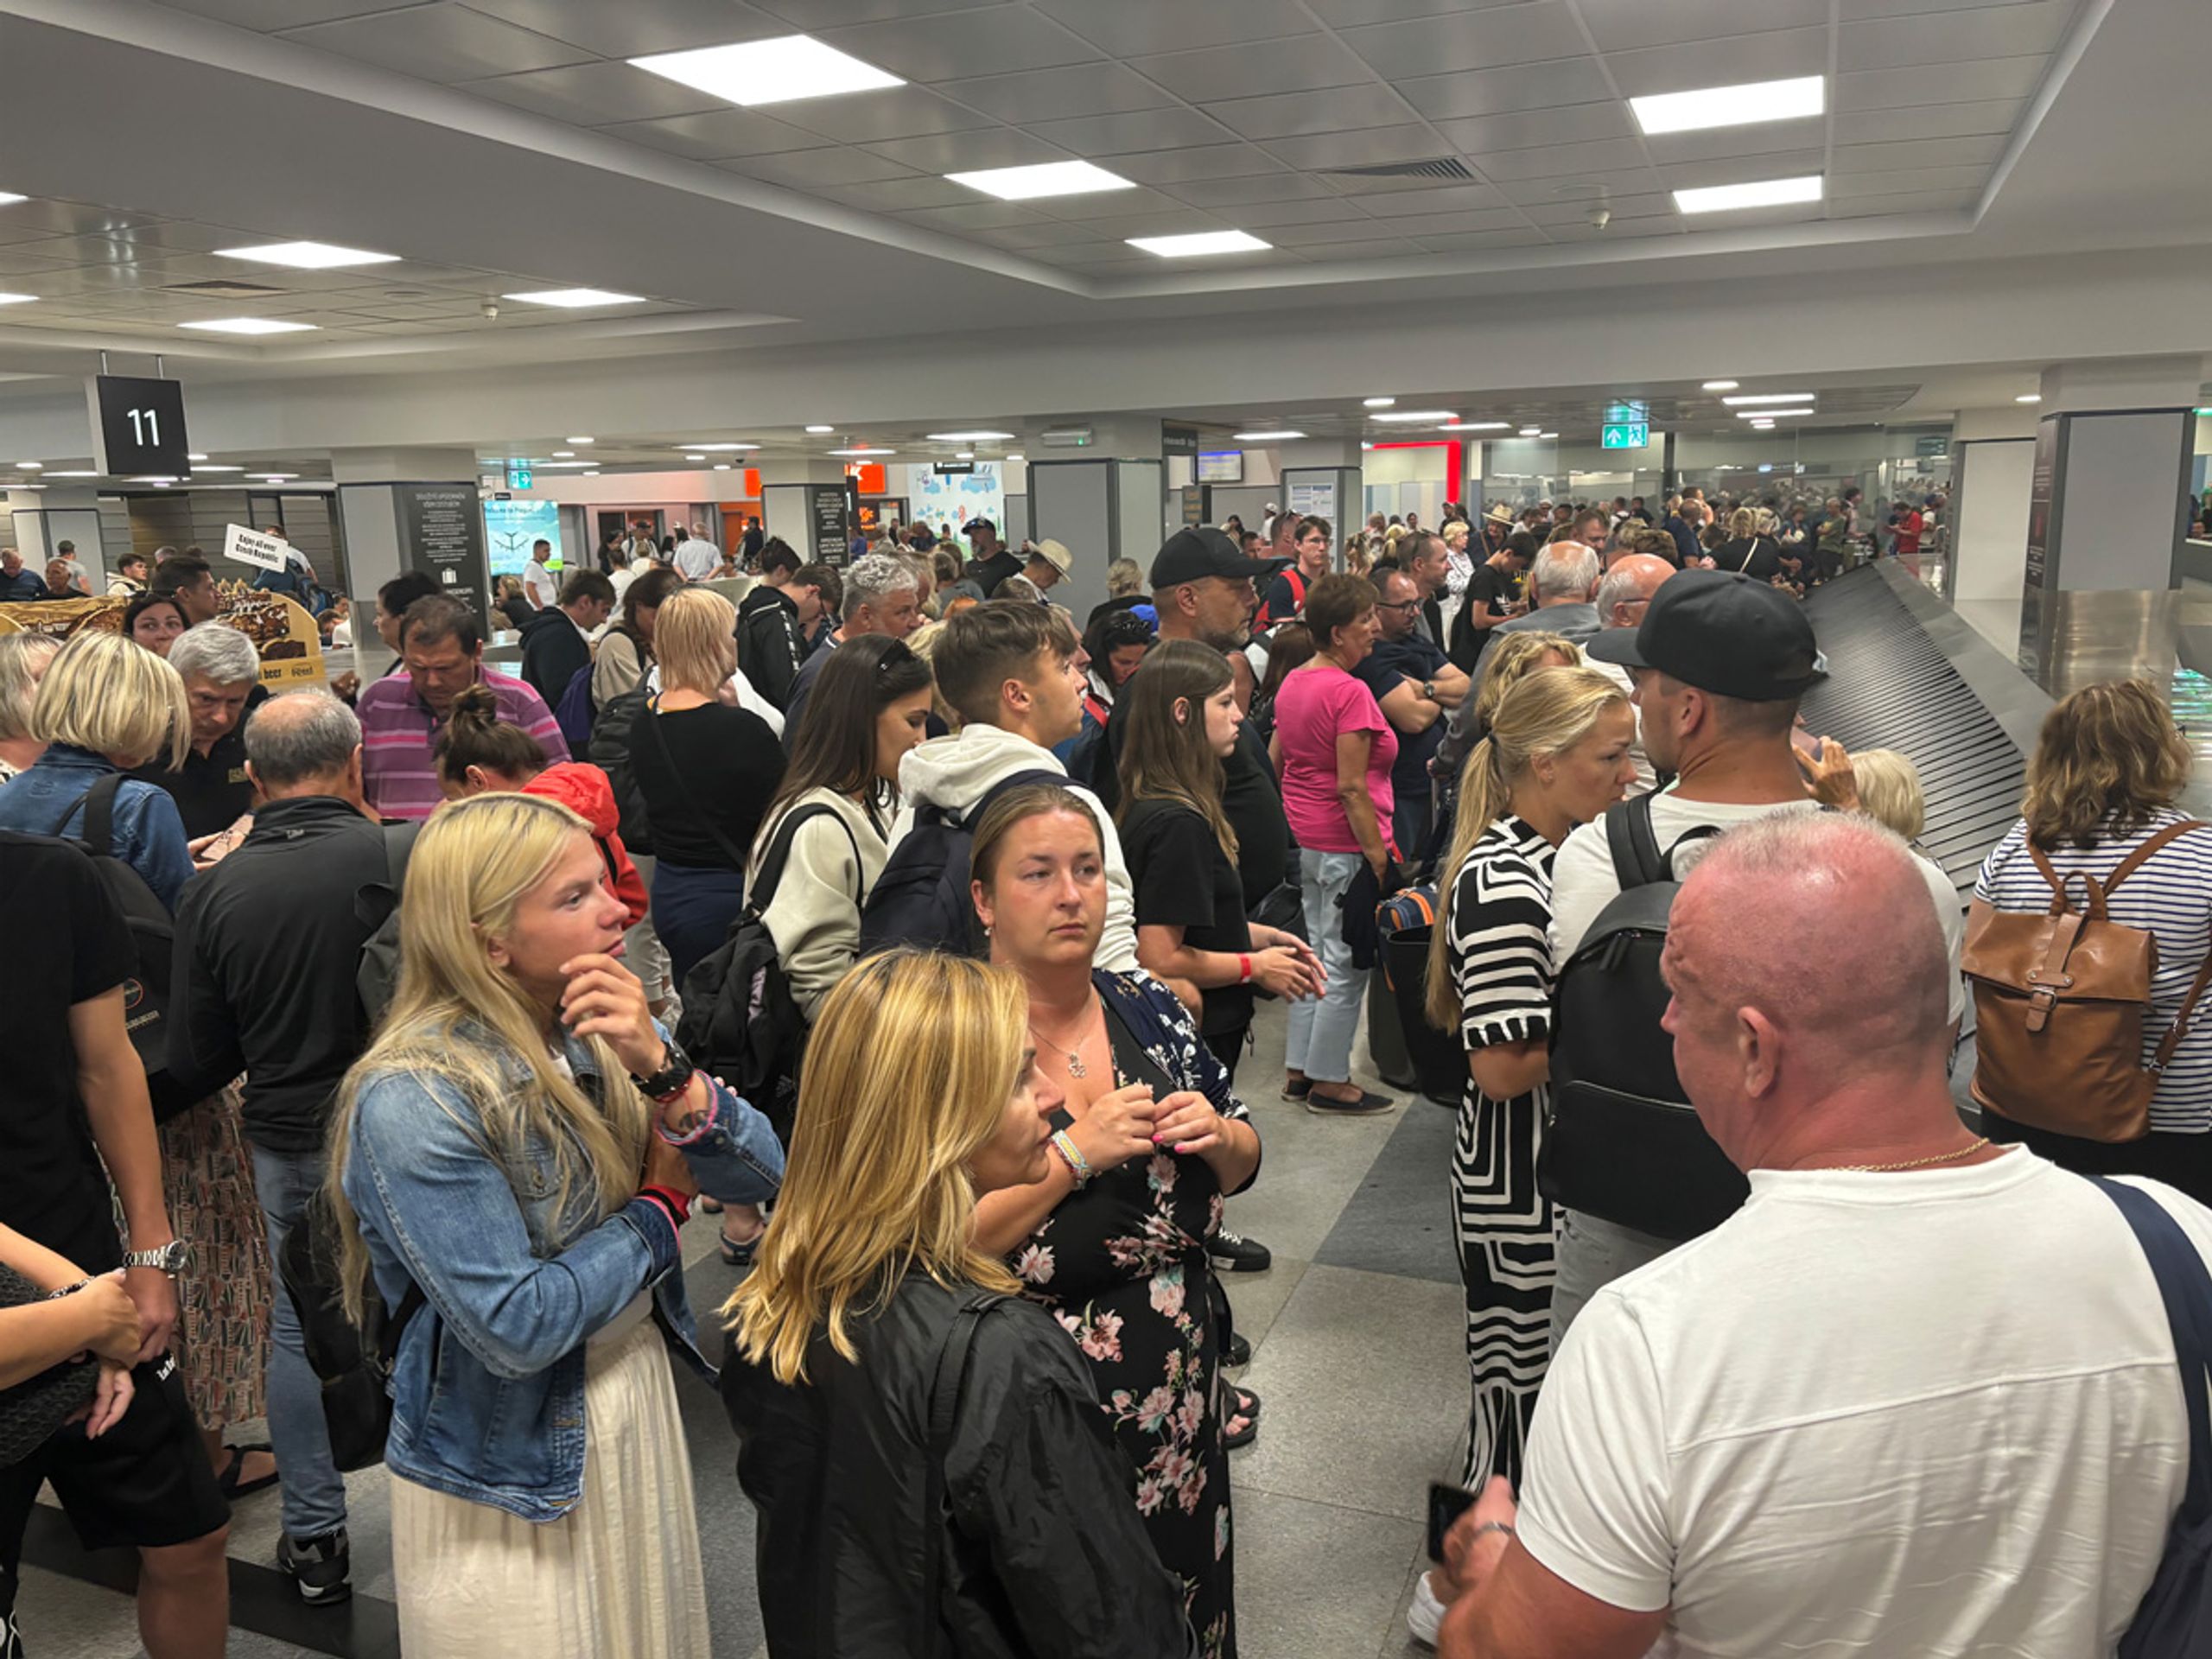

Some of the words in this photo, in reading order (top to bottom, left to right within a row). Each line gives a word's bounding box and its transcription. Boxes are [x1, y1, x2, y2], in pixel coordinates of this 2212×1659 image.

[127, 409, 159, 446] 11
[238, 534, 255, 546] Enjoy
[264, 543, 276, 552] over
[235, 543, 253, 556] Czech
[254, 549, 278, 563] Republic
[264, 668, 282, 679] beer
